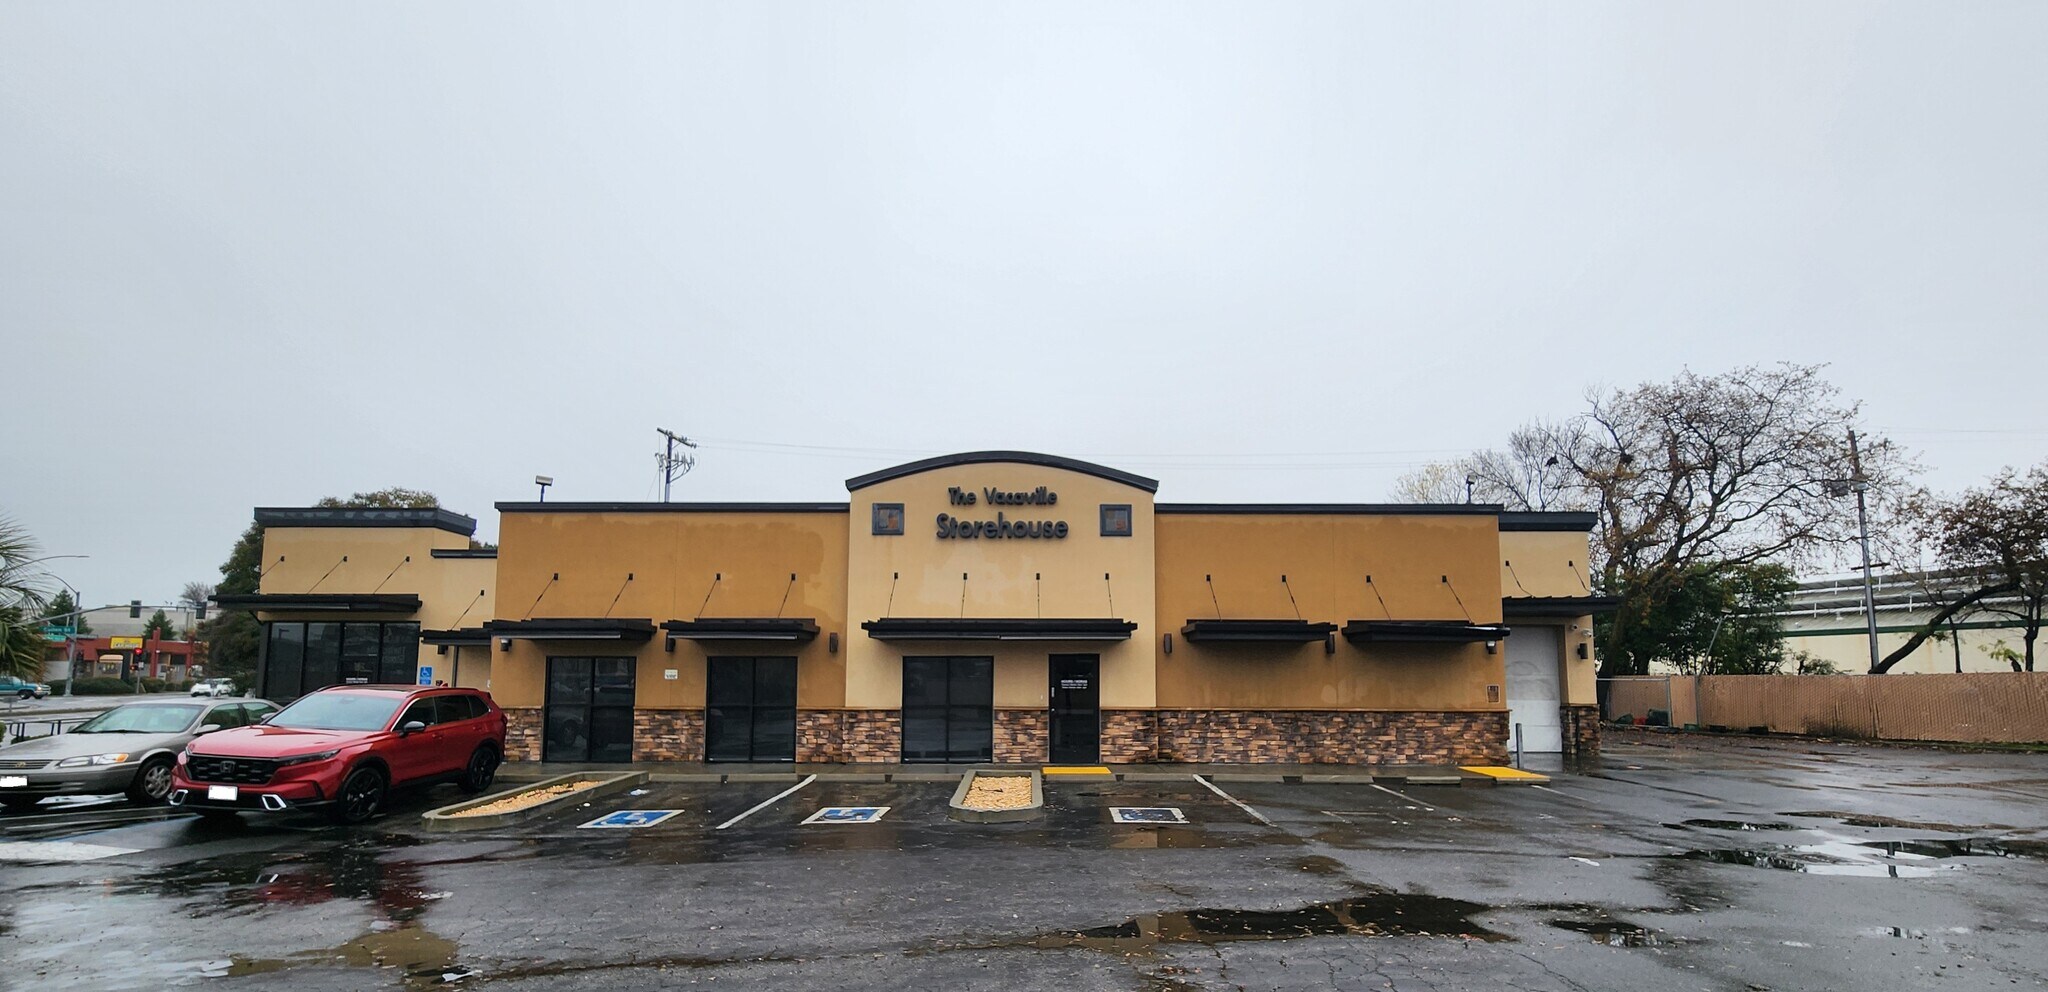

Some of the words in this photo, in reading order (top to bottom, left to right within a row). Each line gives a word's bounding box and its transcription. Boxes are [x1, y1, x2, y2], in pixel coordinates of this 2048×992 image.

[948, 486, 977, 505] The
[984, 486, 1058, 505] Vacaville
[936, 512, 1069, 539] Storehouse
